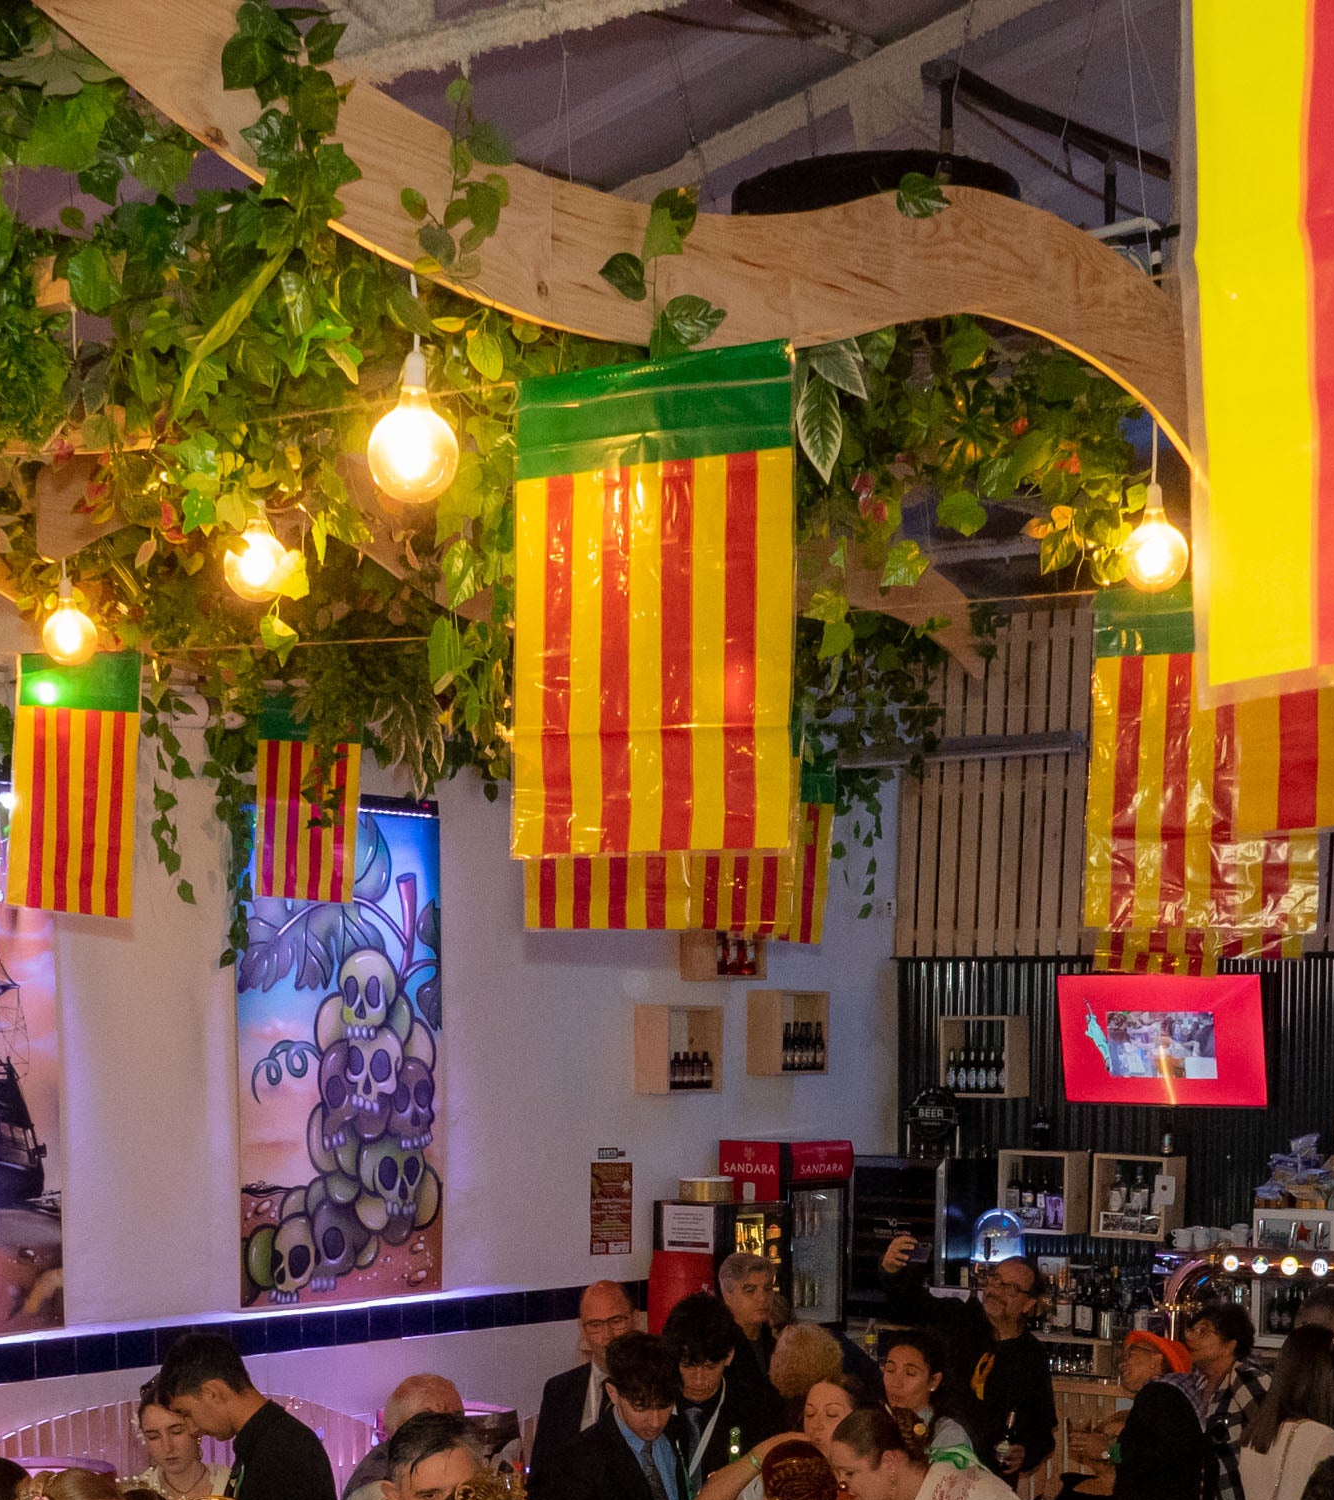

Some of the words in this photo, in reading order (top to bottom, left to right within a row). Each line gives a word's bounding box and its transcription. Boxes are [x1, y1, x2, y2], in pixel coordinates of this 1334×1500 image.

[918, 1108, 944, 1118] BEER
[724, 1162, 776, 1175] SANDARA
[799, 1163, 844, 1175] SANDARA
